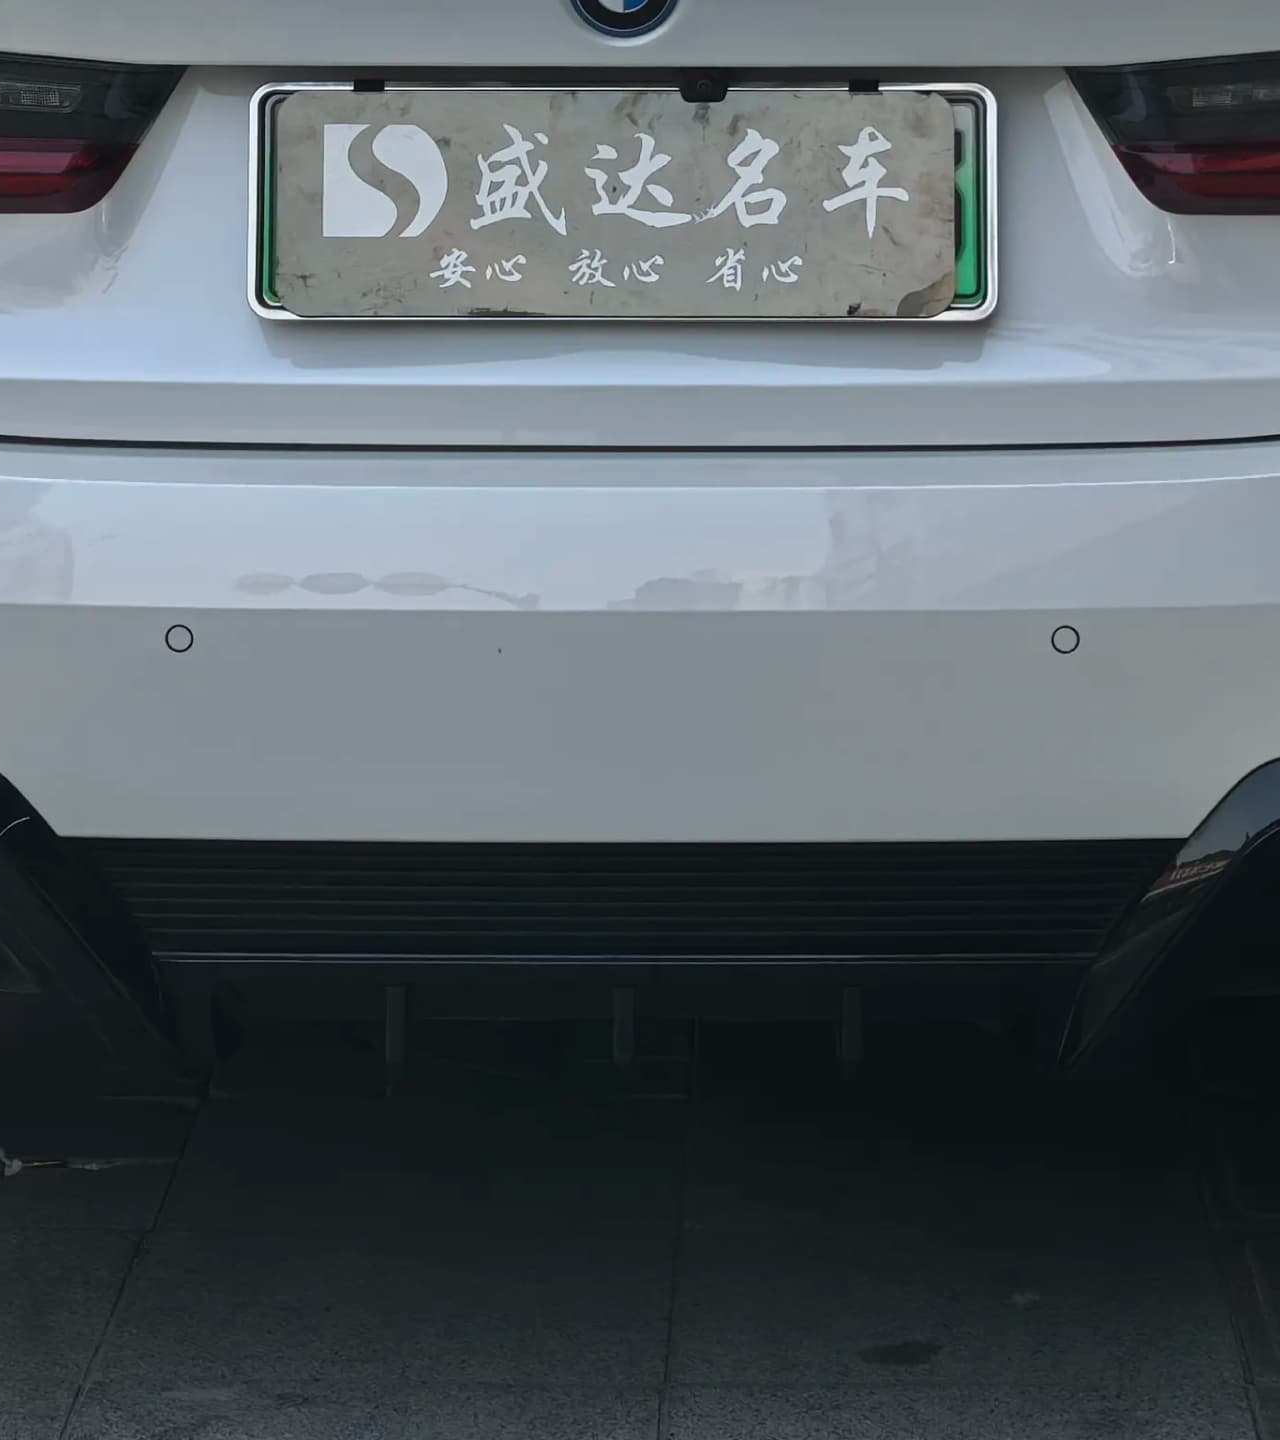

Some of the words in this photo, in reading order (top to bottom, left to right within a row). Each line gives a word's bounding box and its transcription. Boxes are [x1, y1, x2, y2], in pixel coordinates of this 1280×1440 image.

[470, 122, 910, 240] 盛达名车
[429, 247, 526, 290] 安心
[568, 247, 665, 289] 放心
[705, 246, 804, 291] 省心
